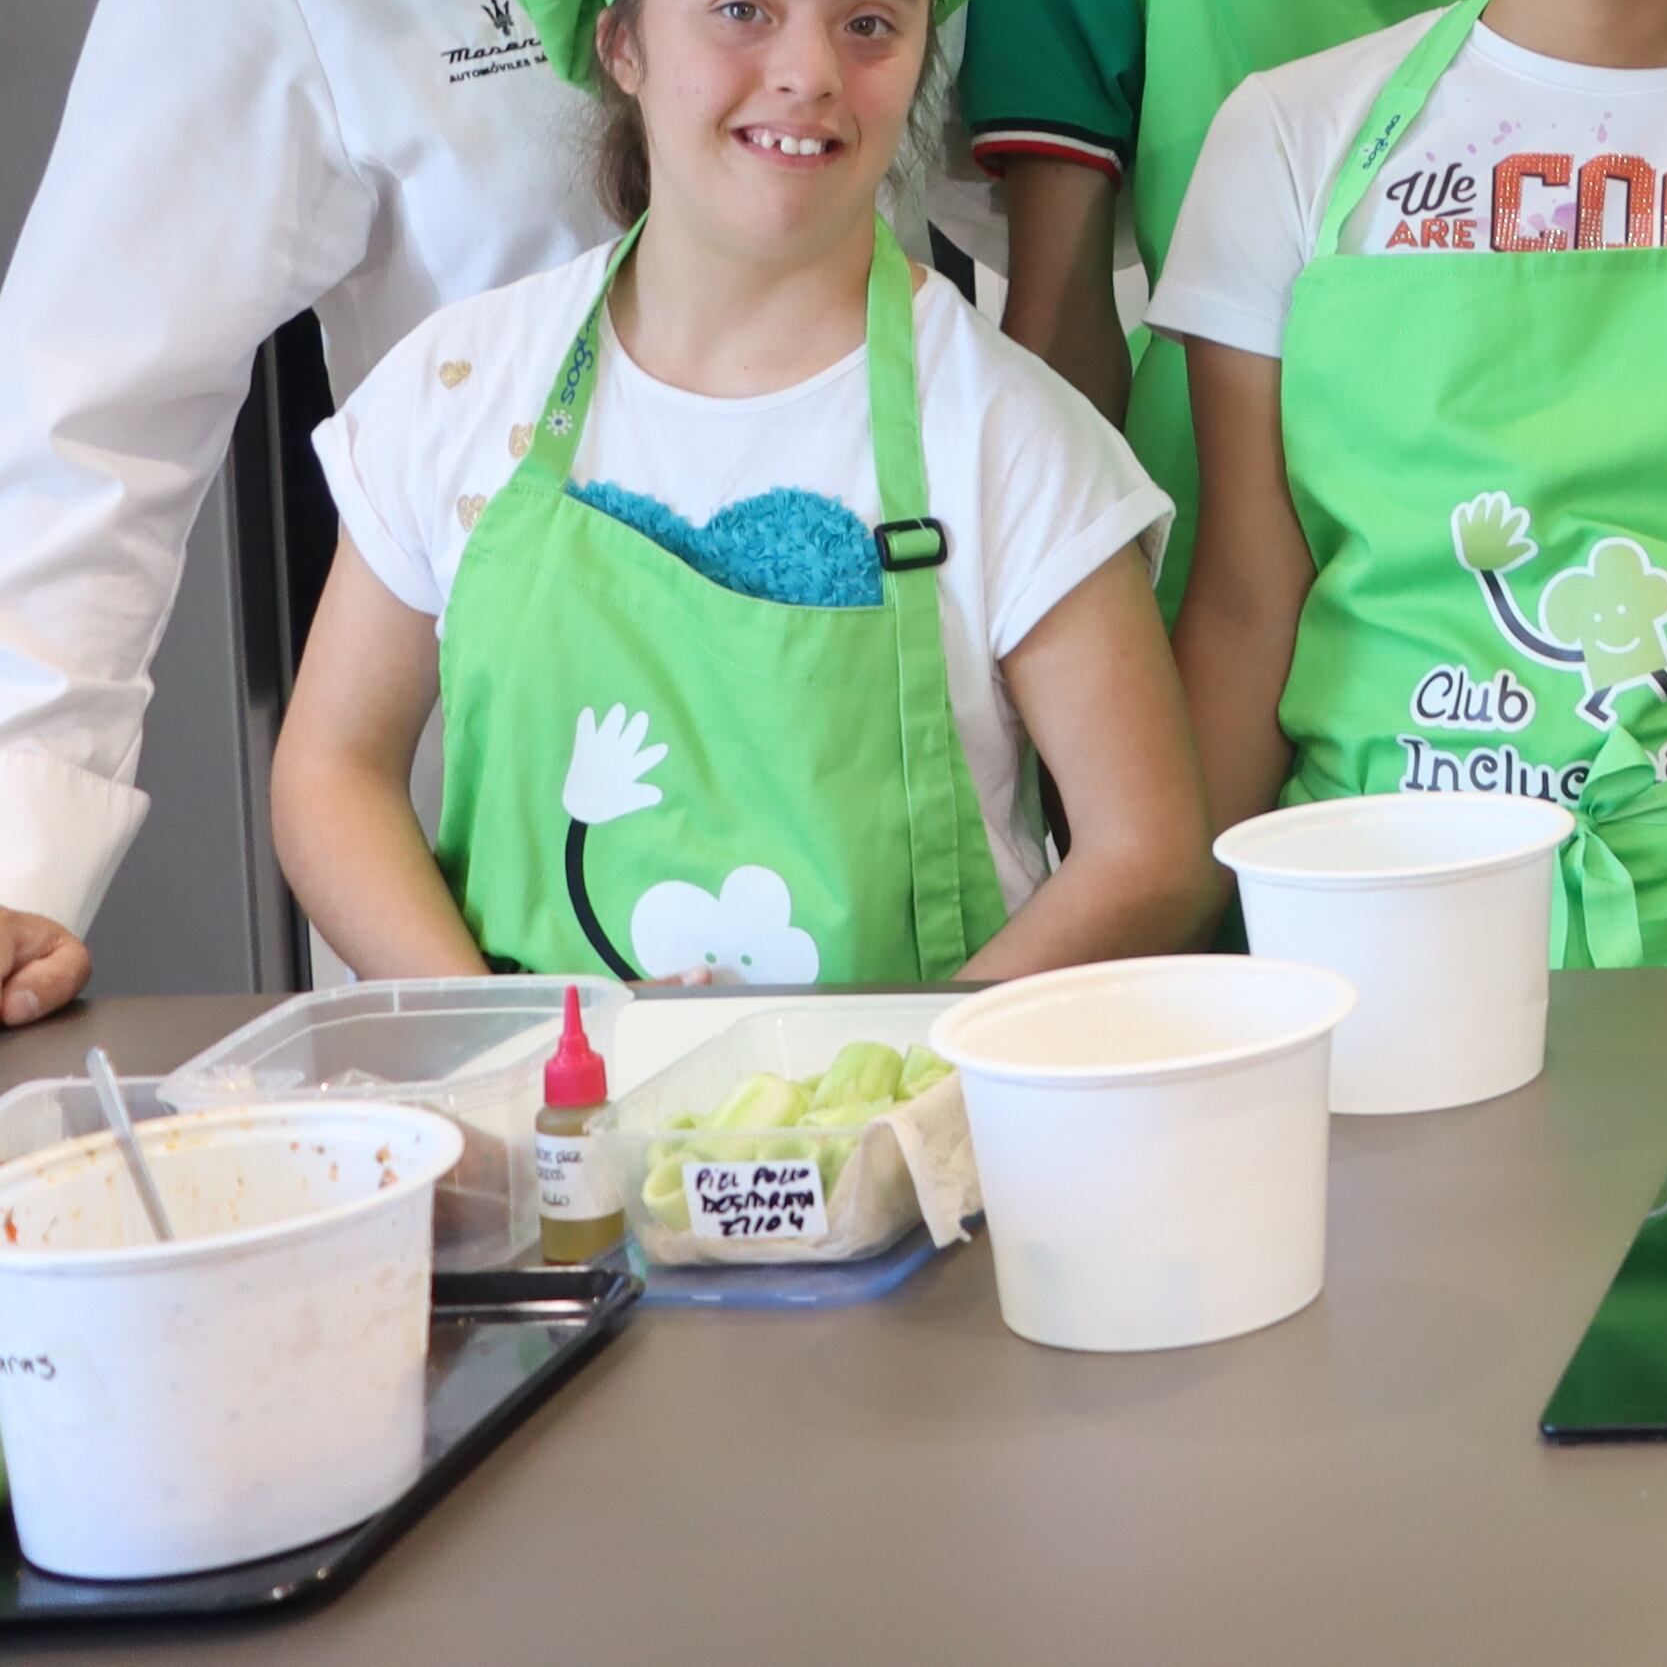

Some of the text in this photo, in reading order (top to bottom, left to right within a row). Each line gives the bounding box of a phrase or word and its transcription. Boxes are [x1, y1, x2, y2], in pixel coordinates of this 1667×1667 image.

[1386, 162, 1477, 217] We
[1384, 218, 1477, 250] ARE
[1416, 670, 1528, 724] Club
